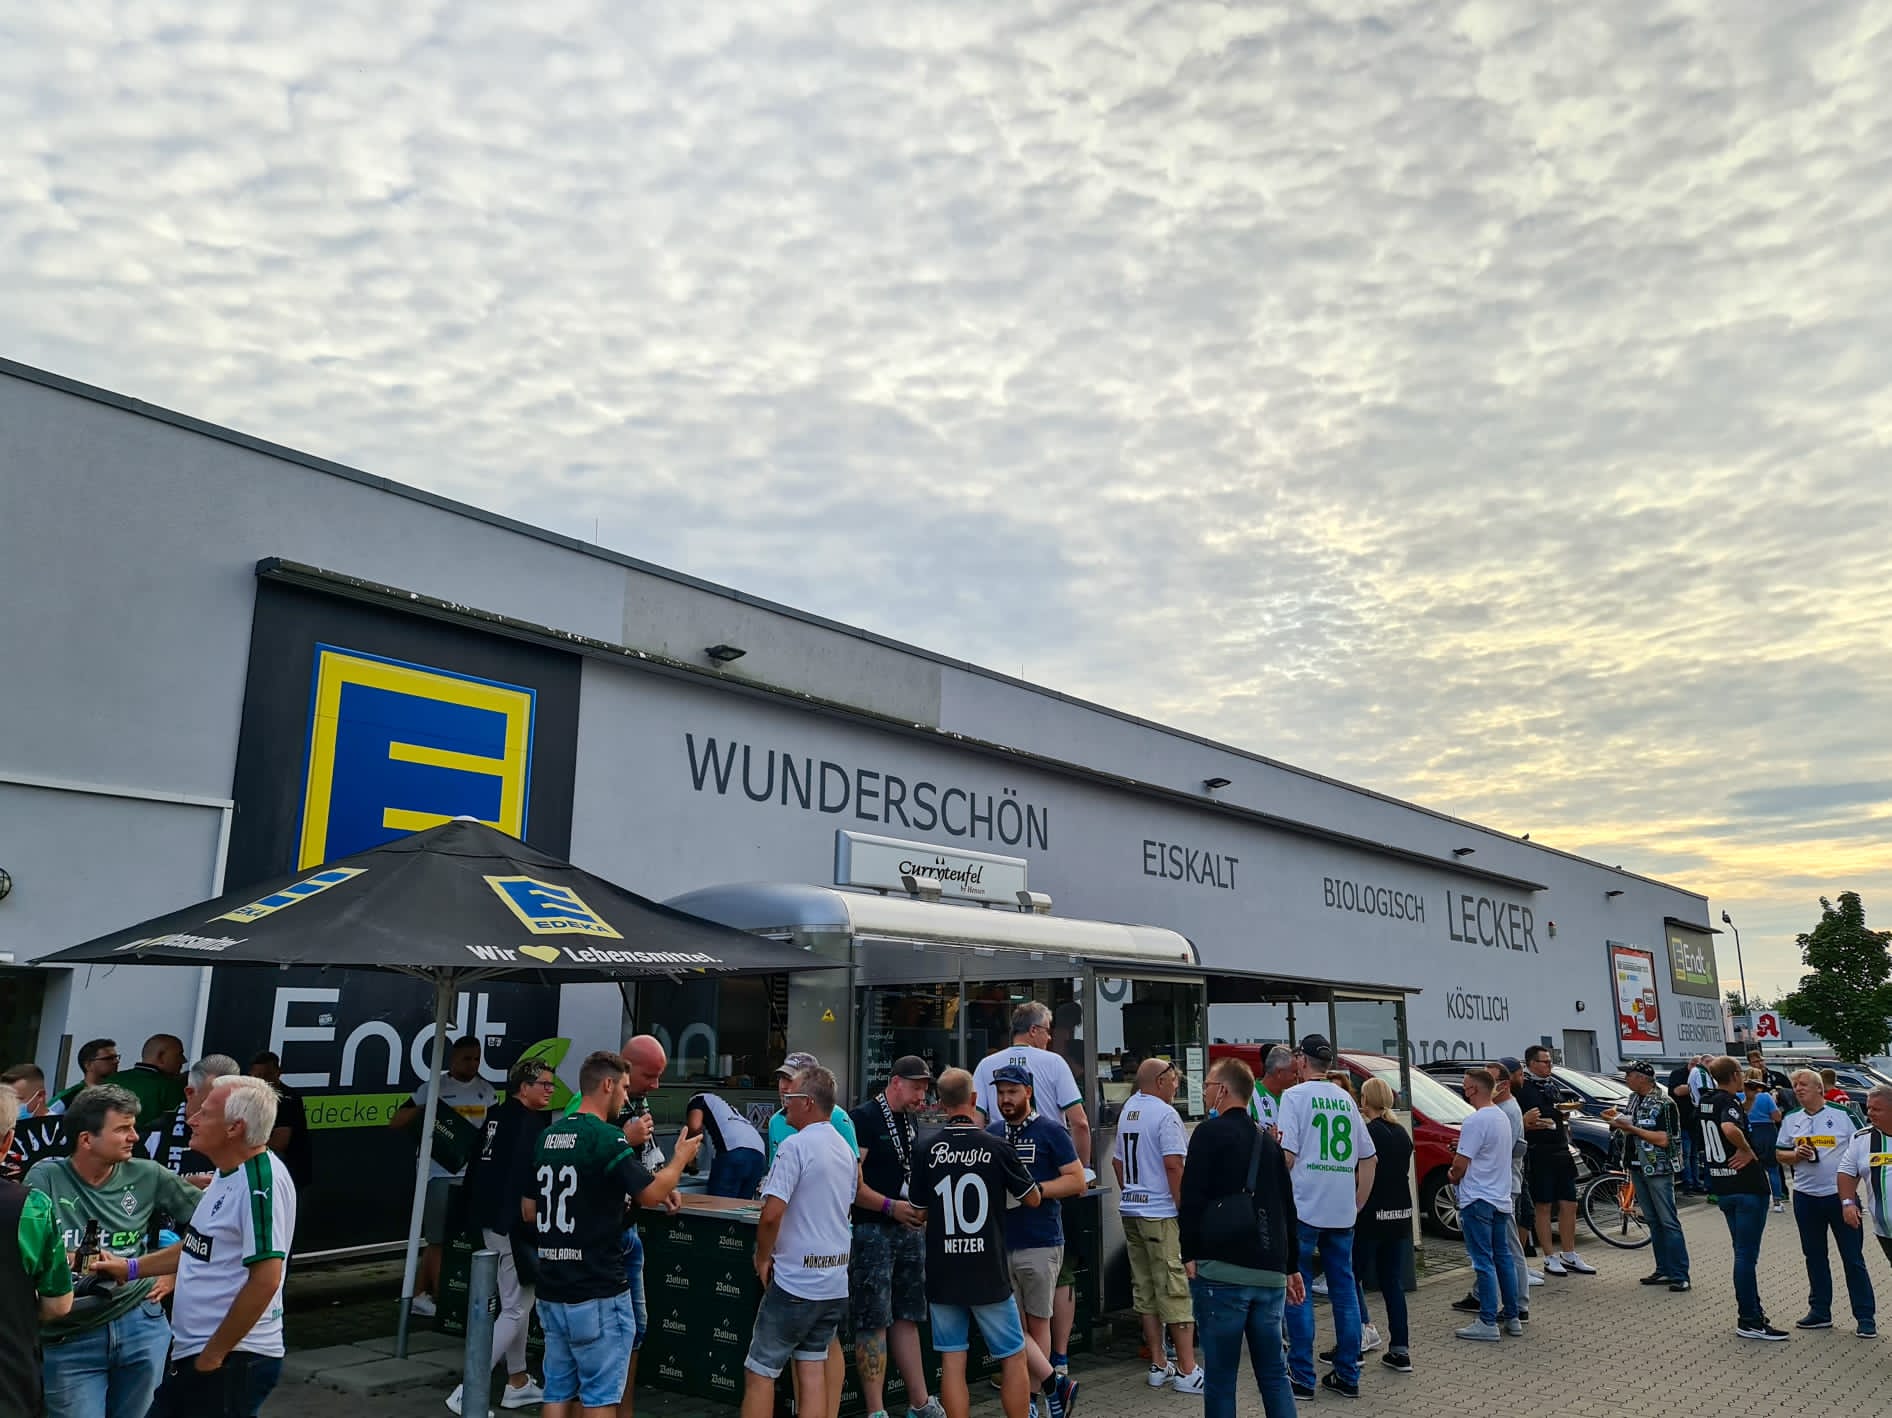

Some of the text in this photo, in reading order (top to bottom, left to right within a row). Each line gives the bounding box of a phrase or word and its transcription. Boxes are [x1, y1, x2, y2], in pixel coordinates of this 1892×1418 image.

[685, 732, 1049, 851] WUNDERSCHÖN
[898, 858, 984, 887] Curryteufel
[1143, 839, 1239, 890] EISKALT
[1323, 877, 1425, 924] BIOLOGISCH
[534, 920, 611, 934] EDEKA
[1446, 890, 1539, 954] LECKER
[465, 944, 517, 962] Wir
[1684, 943, 1706, 975] Endt
[1446, 986, 1510, 1022] KÖSTLICH
[1678, 1024, 1722, 1043] LEBENSMITTEL
[1311, 1097, 1352, 1112] ARANGO
[544, 1133, 578, 1149] NEUHAUS
[1312, 1113, 1353, 1162] 18
[1700, 1120, 1726, 1163] 10
[929, 1142, 991, 1168] Borussia
[536, 1165, 578, 1234] 32
[934, 1172, 989, 1235] 10
[62, 1228, 140, 1249] fltEX
[668, 1230, 693, 1241] Bolten
[719, 1235, 744, 1247] Bolten
[944, 1237, 985, 1254] NETZER
[665, 1274, 689, 1286] Bolten
[715, 1281, 740, 1295] Bolten
[662, 1318, 687, 1331] Bolten
[713, 1327, 738, 1341] Bolten
[659, 1364, 684, 1377] Bolten
[711, 1373, 735, 1388] Bolten
